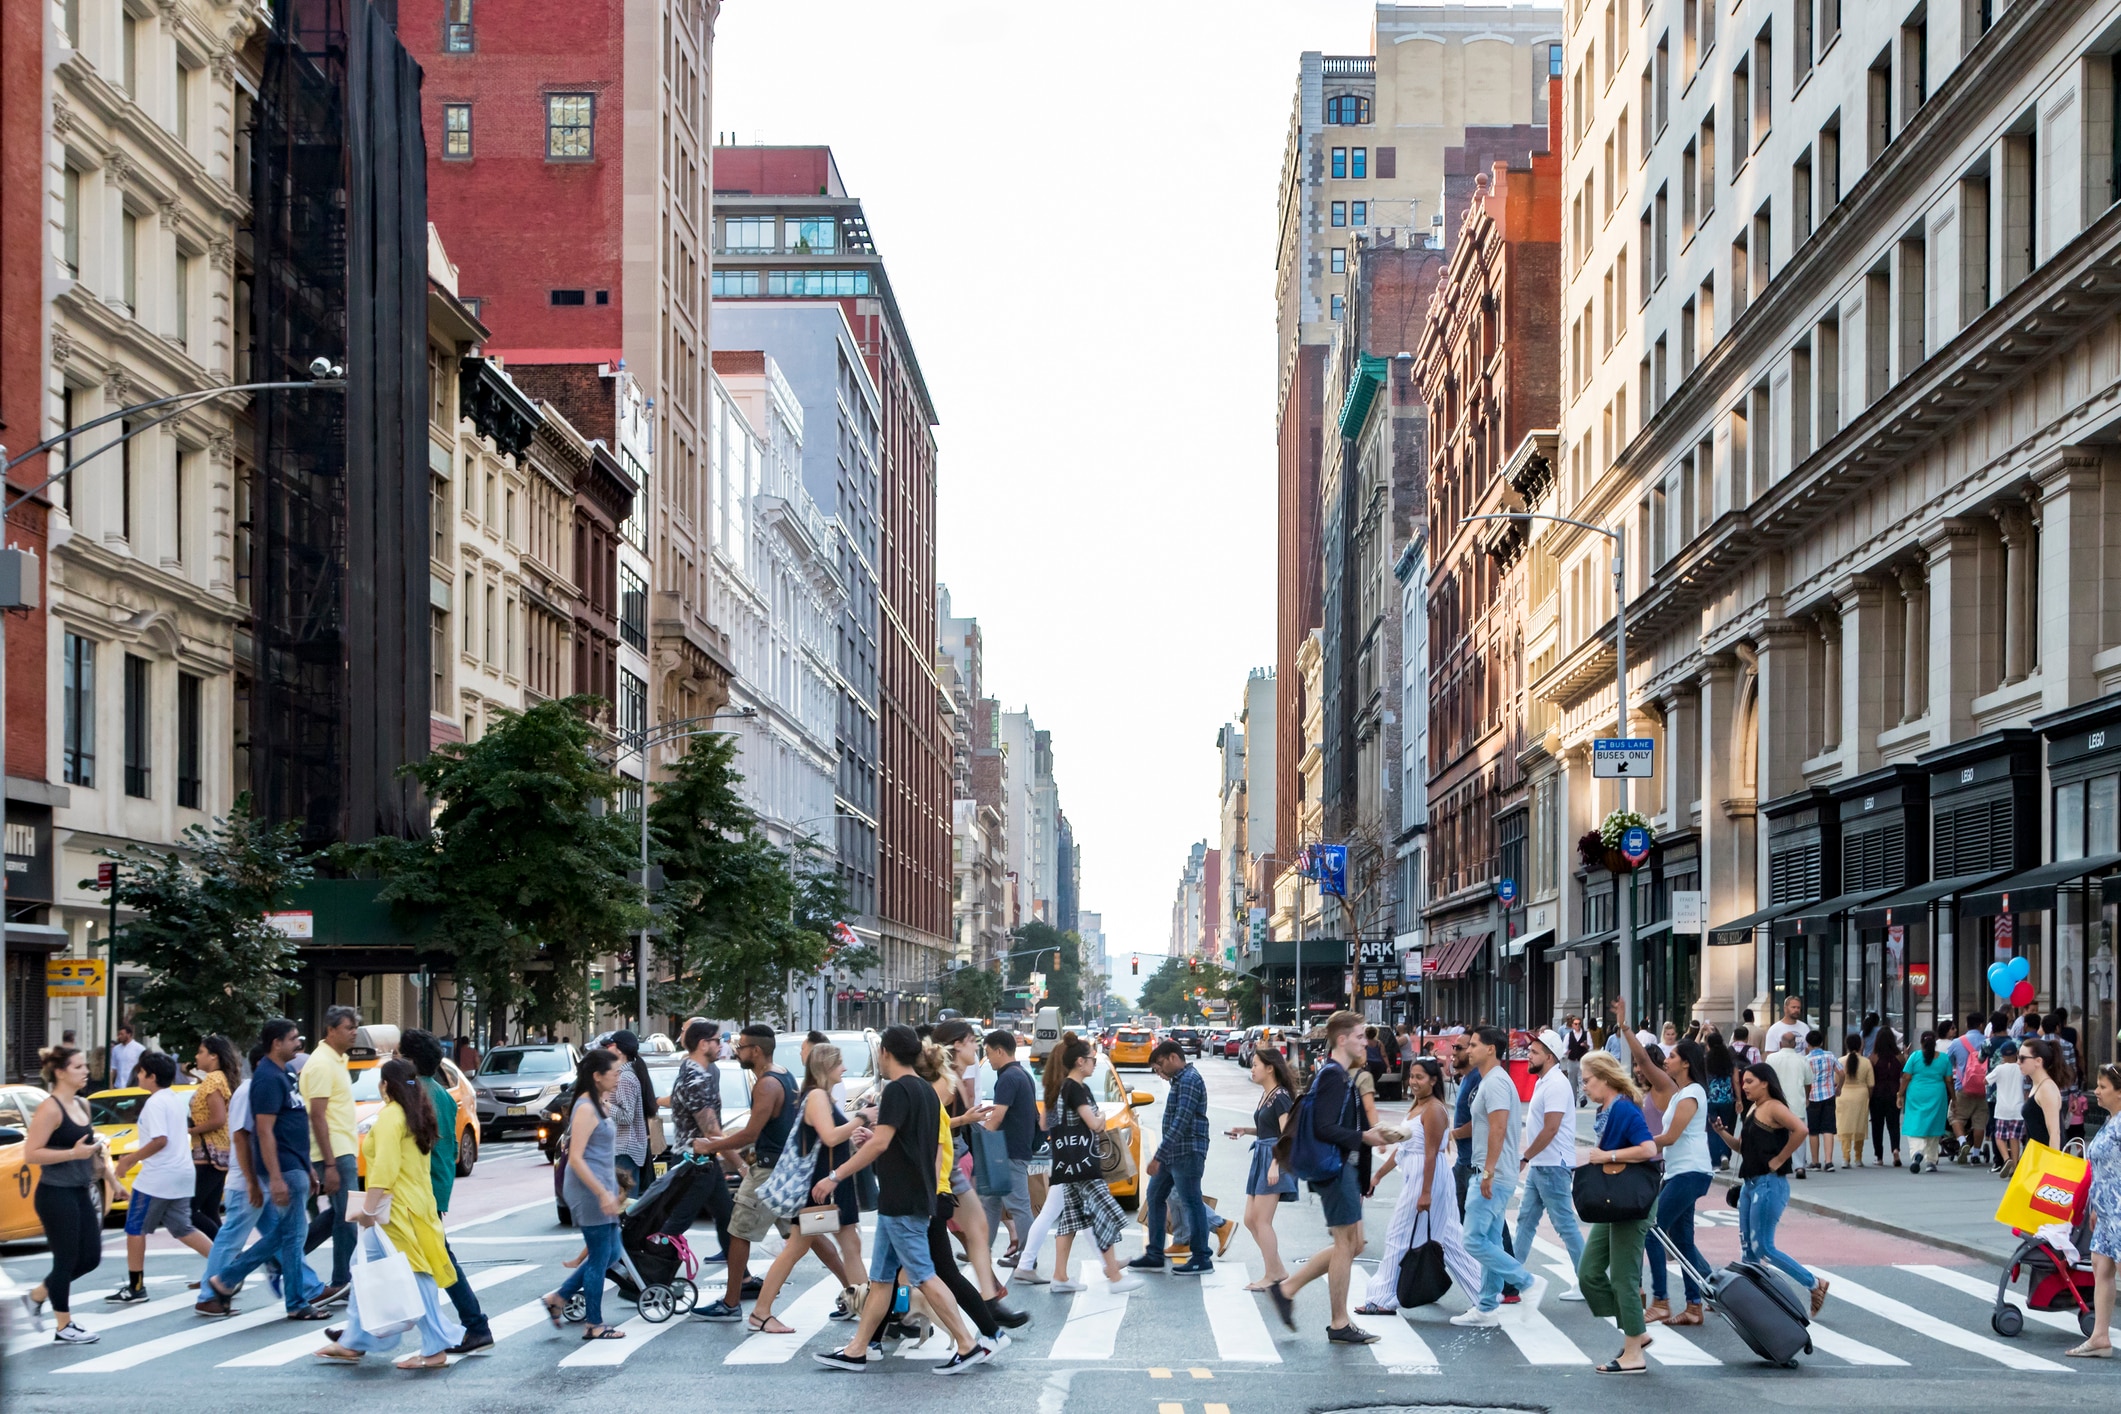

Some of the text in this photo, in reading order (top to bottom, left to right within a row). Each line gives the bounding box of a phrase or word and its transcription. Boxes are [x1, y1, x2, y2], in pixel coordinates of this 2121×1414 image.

[2088, 731, 2105, 749] LEGO
[1597, 751, 1650, 760] BUSES ONLY
[1961, 768, 1974, 783] LEGO
[1864, 797, 1875, 810] LEGO
[1908, 974, 1926, 985] EGO
[1037, 1031, 1057, 1039] 9G17
[1055, 1135, 1089, 1149] BIEN
[1055, 1157, 1092, 1175] FAIT
[2036, 1185, 2074, 1205] LEGO
